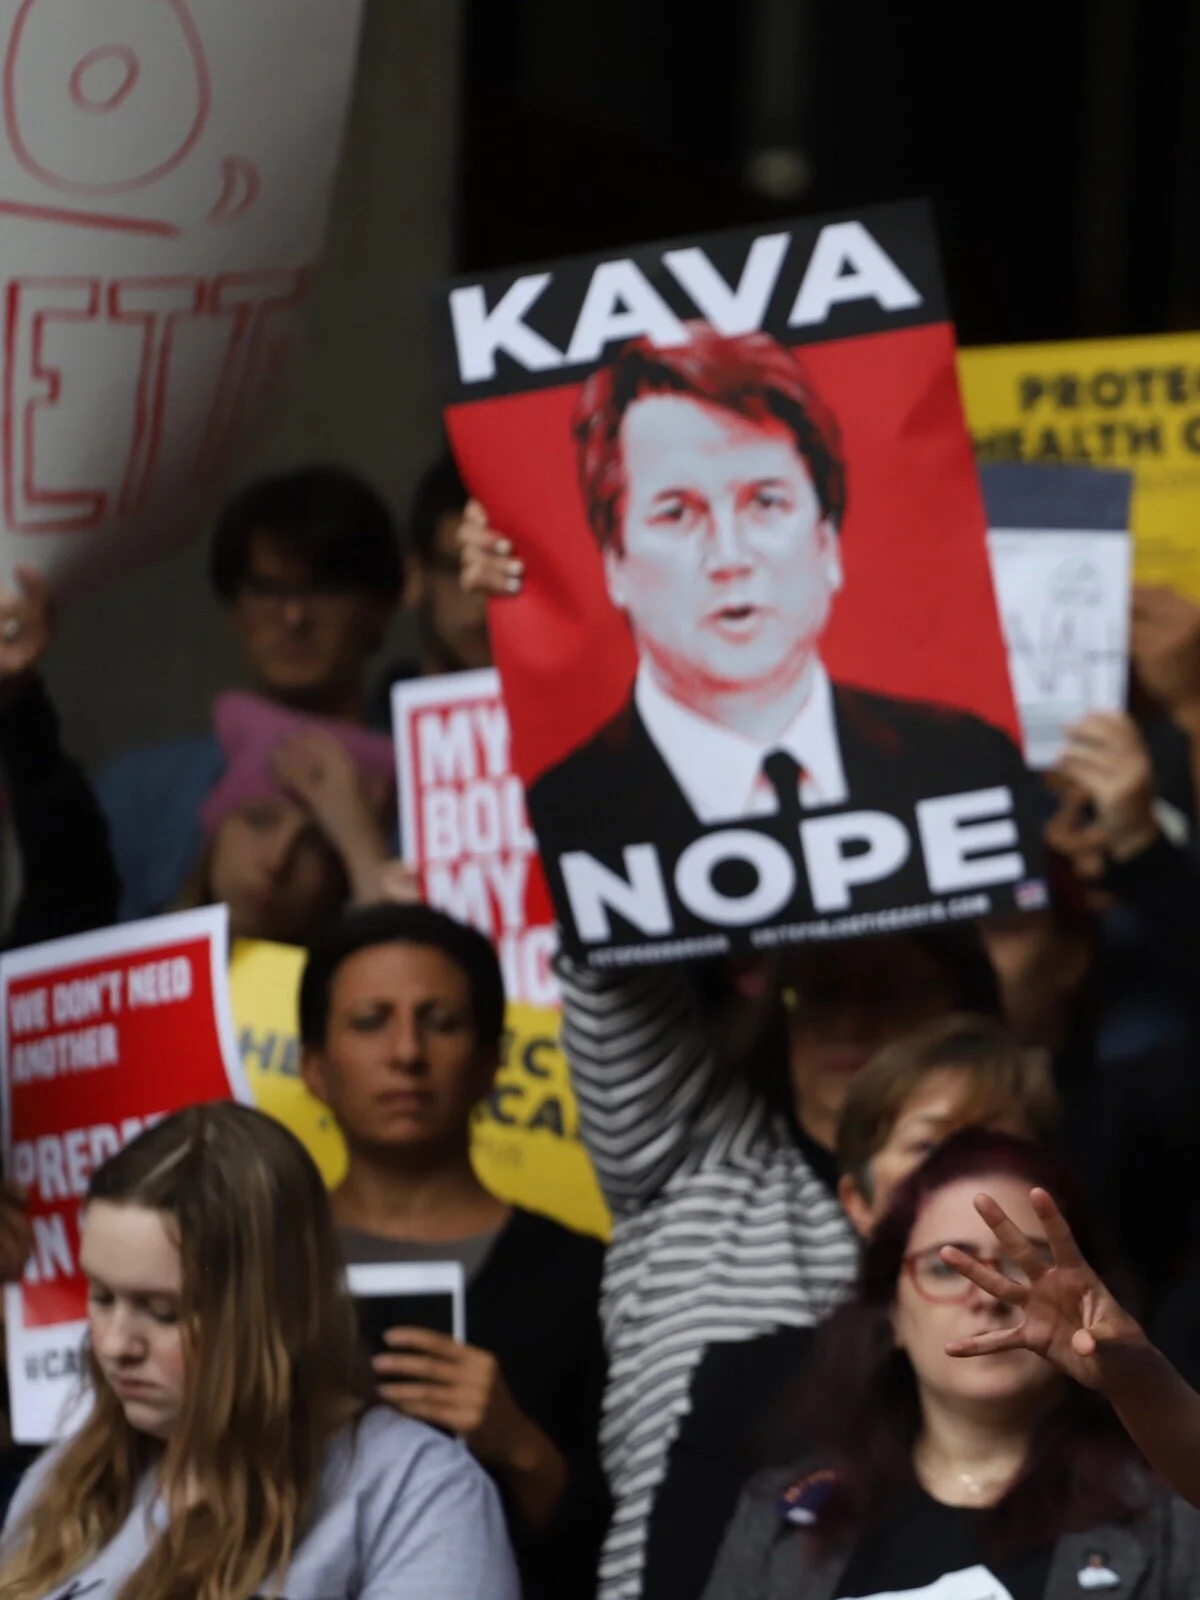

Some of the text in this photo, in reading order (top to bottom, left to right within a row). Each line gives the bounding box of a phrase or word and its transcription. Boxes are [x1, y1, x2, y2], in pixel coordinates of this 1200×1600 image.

[448, 220, 924, 385] KAVA
[418, 709, 510, 787] MY
[560, 786, 1026, 944] NOPE
[11, 956, 192, 1035] WE DON'T NEED
[11, 1022, 119, 1083] ANOTHER
